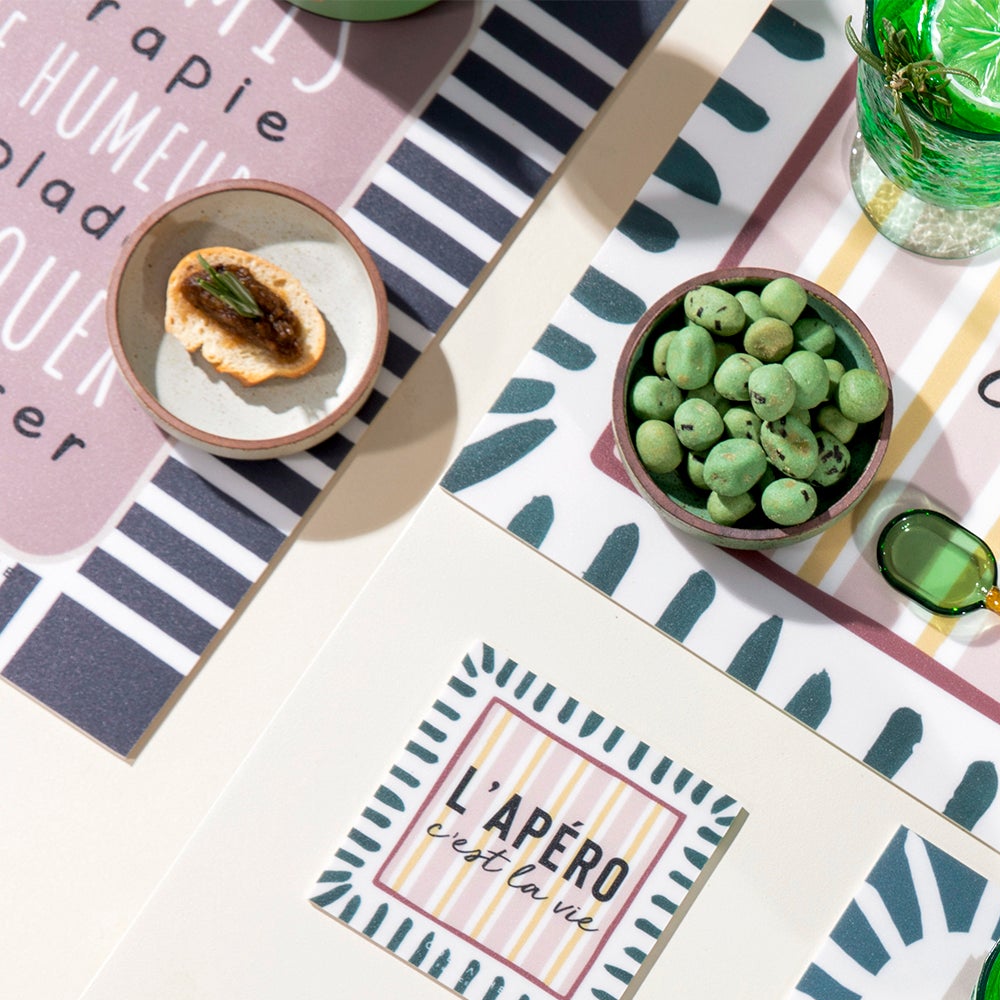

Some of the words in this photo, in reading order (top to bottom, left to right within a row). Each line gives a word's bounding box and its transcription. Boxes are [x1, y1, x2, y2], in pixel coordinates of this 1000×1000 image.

[18, 41, 251, 201] HUMEU
[0, 384, 86, 461] er
[427, 822, 512, 873] c'est
[507, 863, 549, 901] la
[553, 901, 599, 932] vie
[446, 765, 630, 903] L'APÉRO
